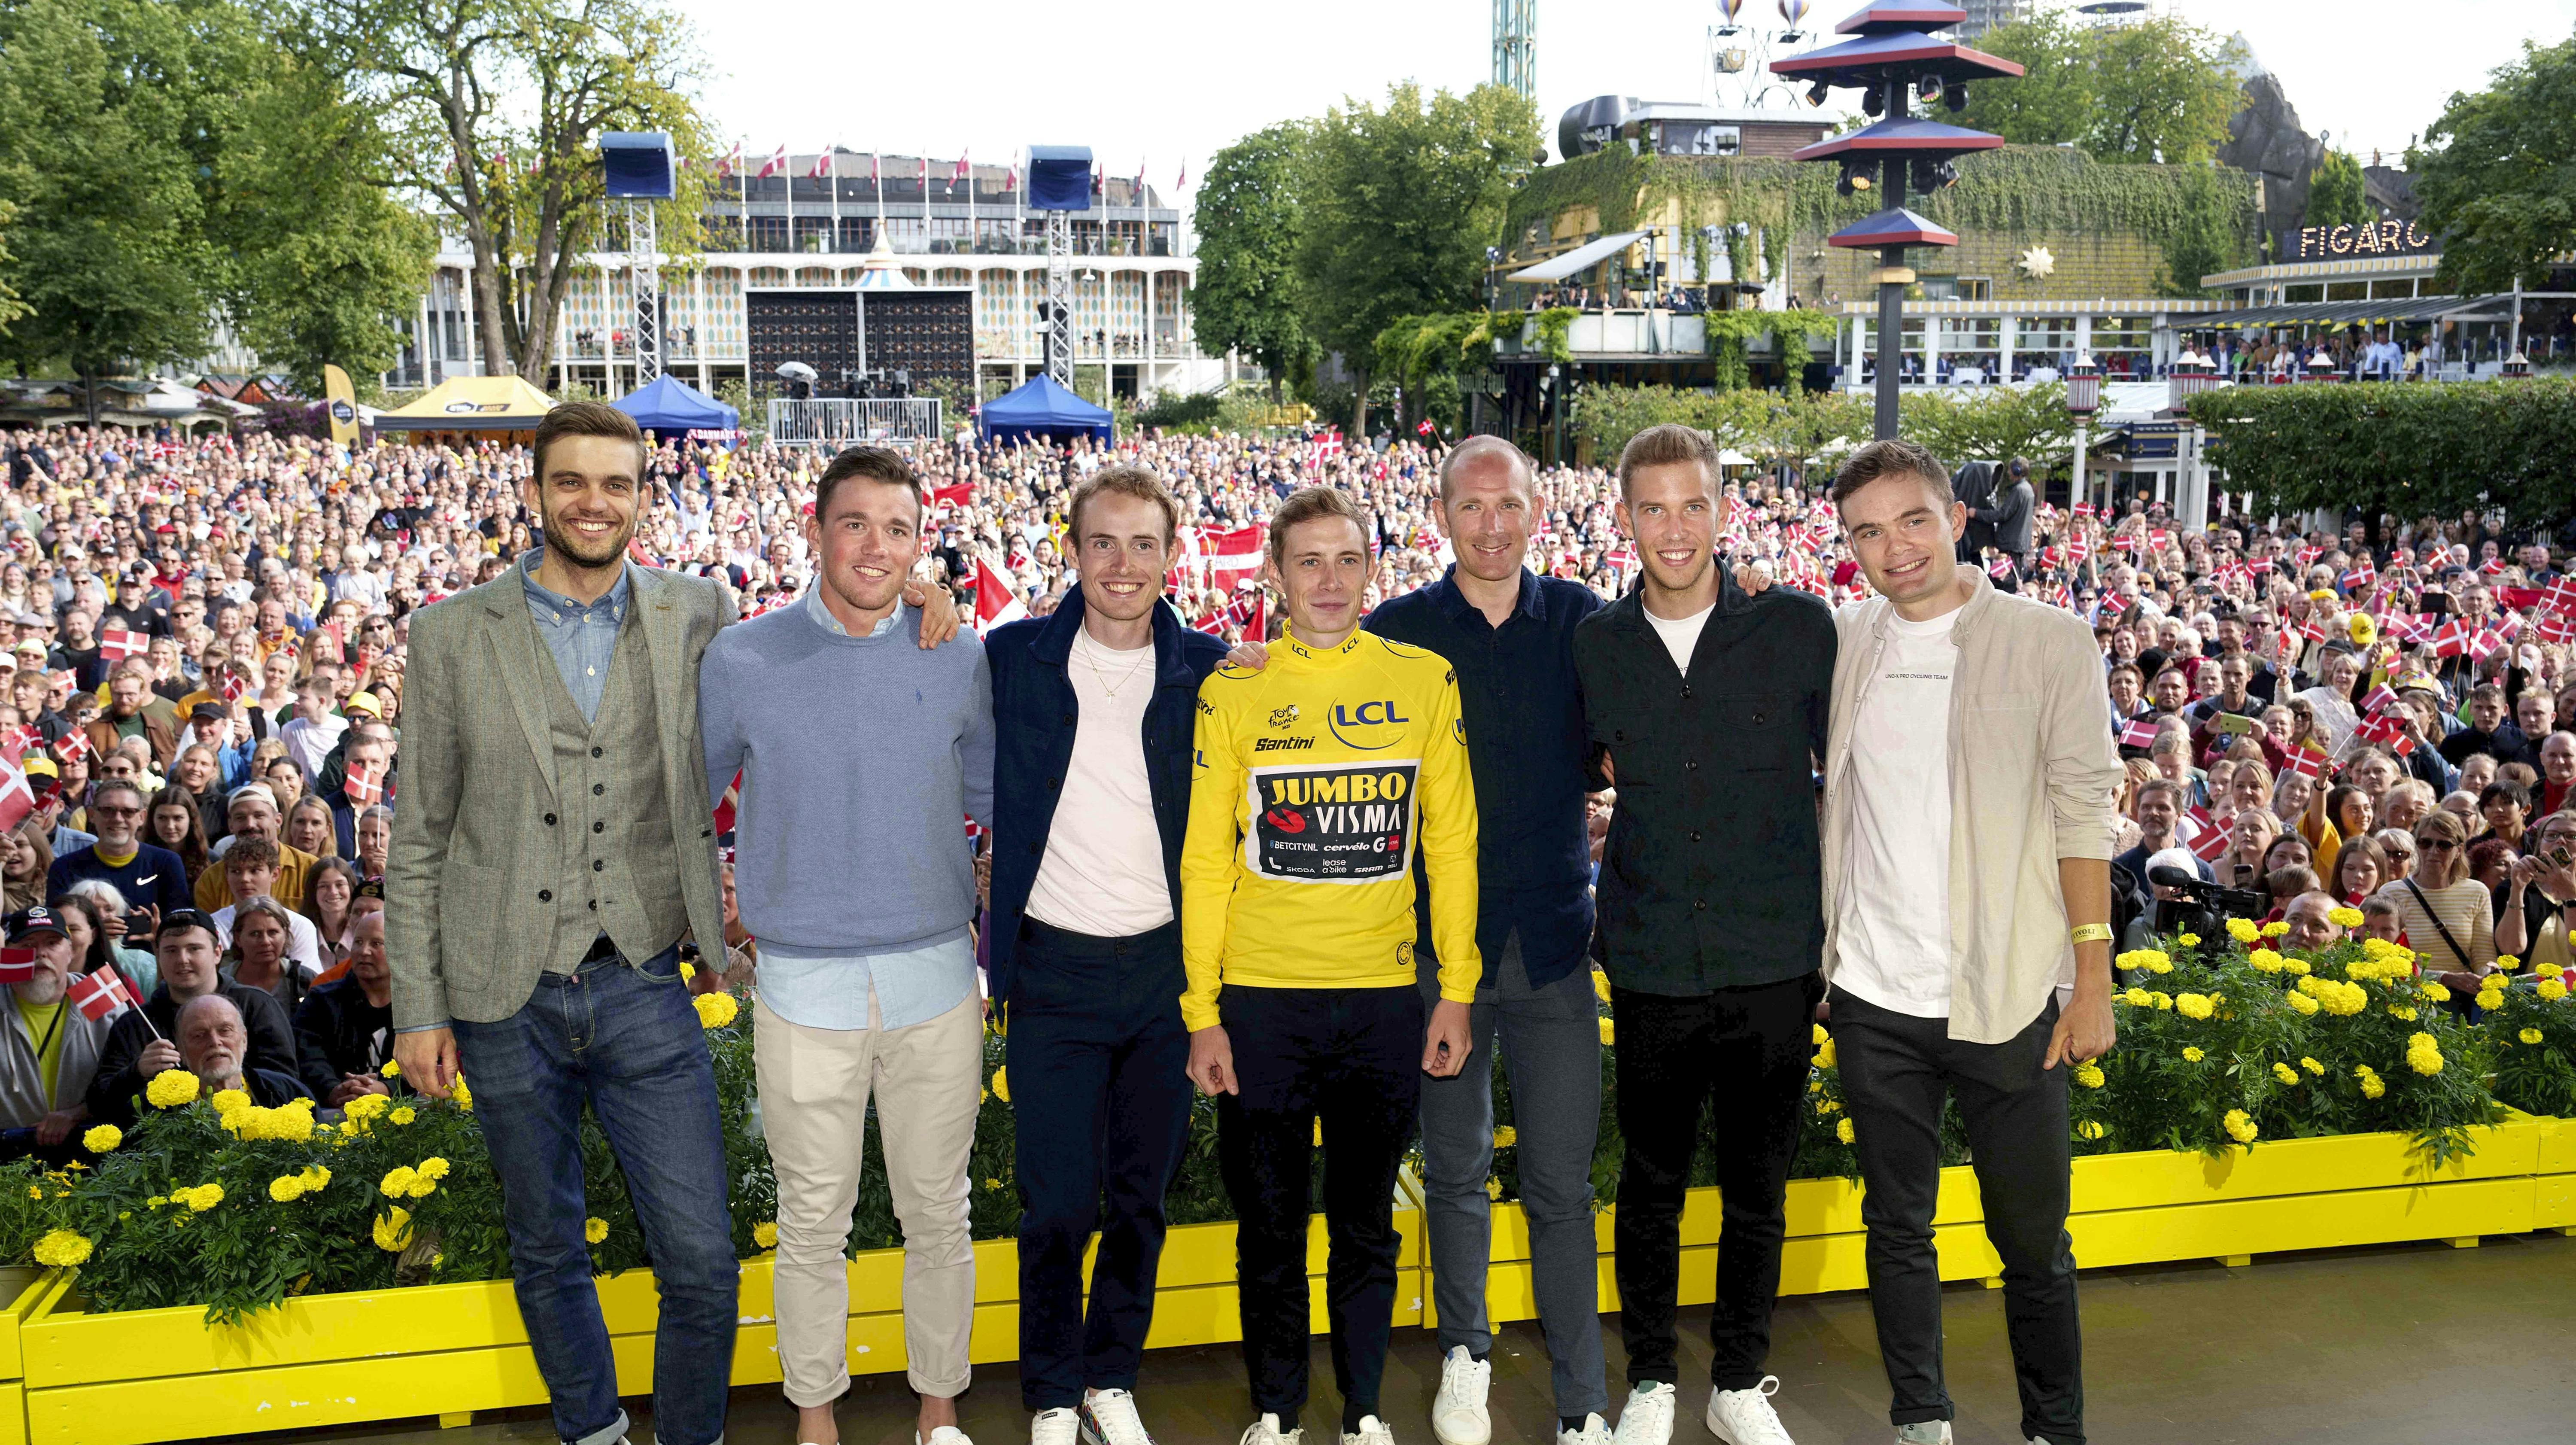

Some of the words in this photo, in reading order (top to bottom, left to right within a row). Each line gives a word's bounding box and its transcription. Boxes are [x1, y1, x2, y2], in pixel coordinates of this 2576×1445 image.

[697, 429, 736, 439] DANMARK
[1292, 643, 1311, 659] LCL
[1342, 637, 1359, 654] LCL
[1336, 701, 1409, 727] LCL
[1255, 736, 1315, 752] Santini
[1272, 772, 1406, 806] JUMBO
[1315, 803, 1401, 834] VISMA
[1275, 841, 1318, 852] BETCITY.NL
[1323, 842, 1370, 851] cervélo
[1354, 865, 1383, 873] SRAM
[2072, 928, 2096, 939] TIVOLI
